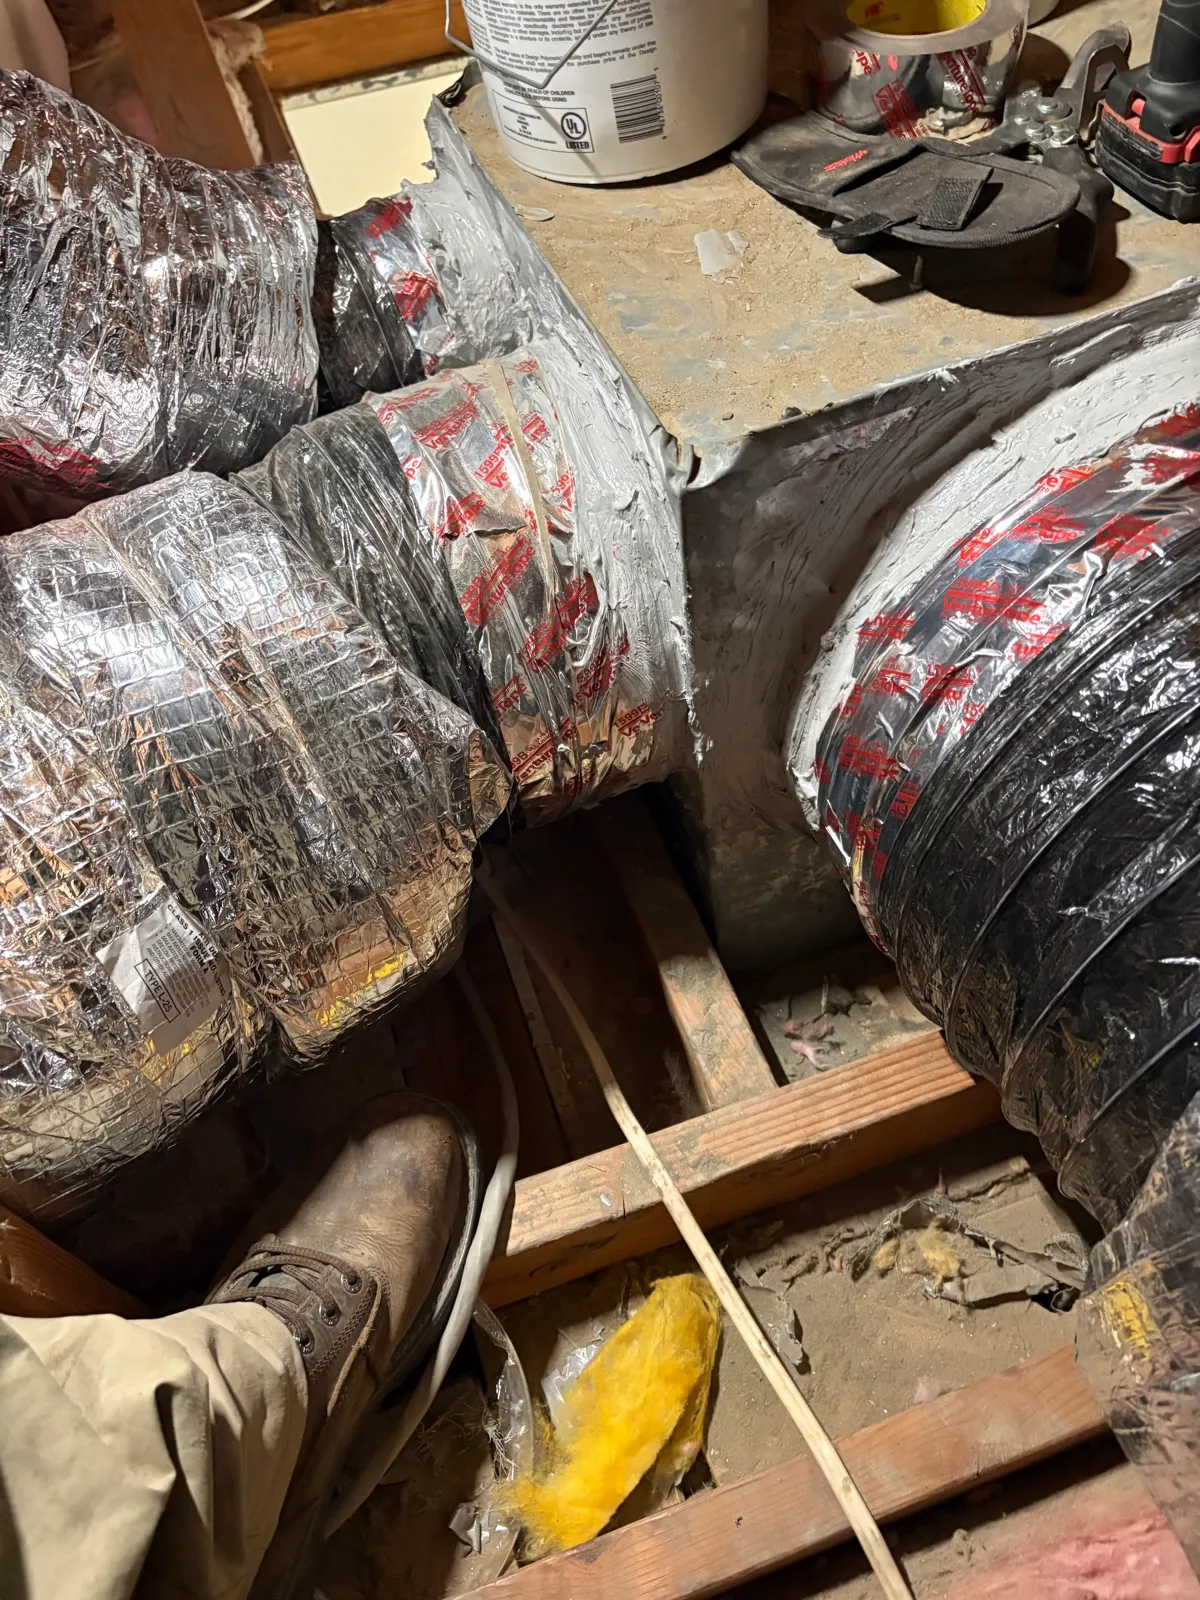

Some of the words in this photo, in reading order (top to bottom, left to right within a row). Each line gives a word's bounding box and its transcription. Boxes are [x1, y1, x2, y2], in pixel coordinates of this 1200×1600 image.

[565, 141, 590, 149] LISTED
[167, 904, 189, 930] CLASS
[194, 935, 211, 960] ISSUE
[190, 945, 204, 968] FORM
[144, 969, 162, 994] TYPE
[157, 993, 173, 1012] L-25
